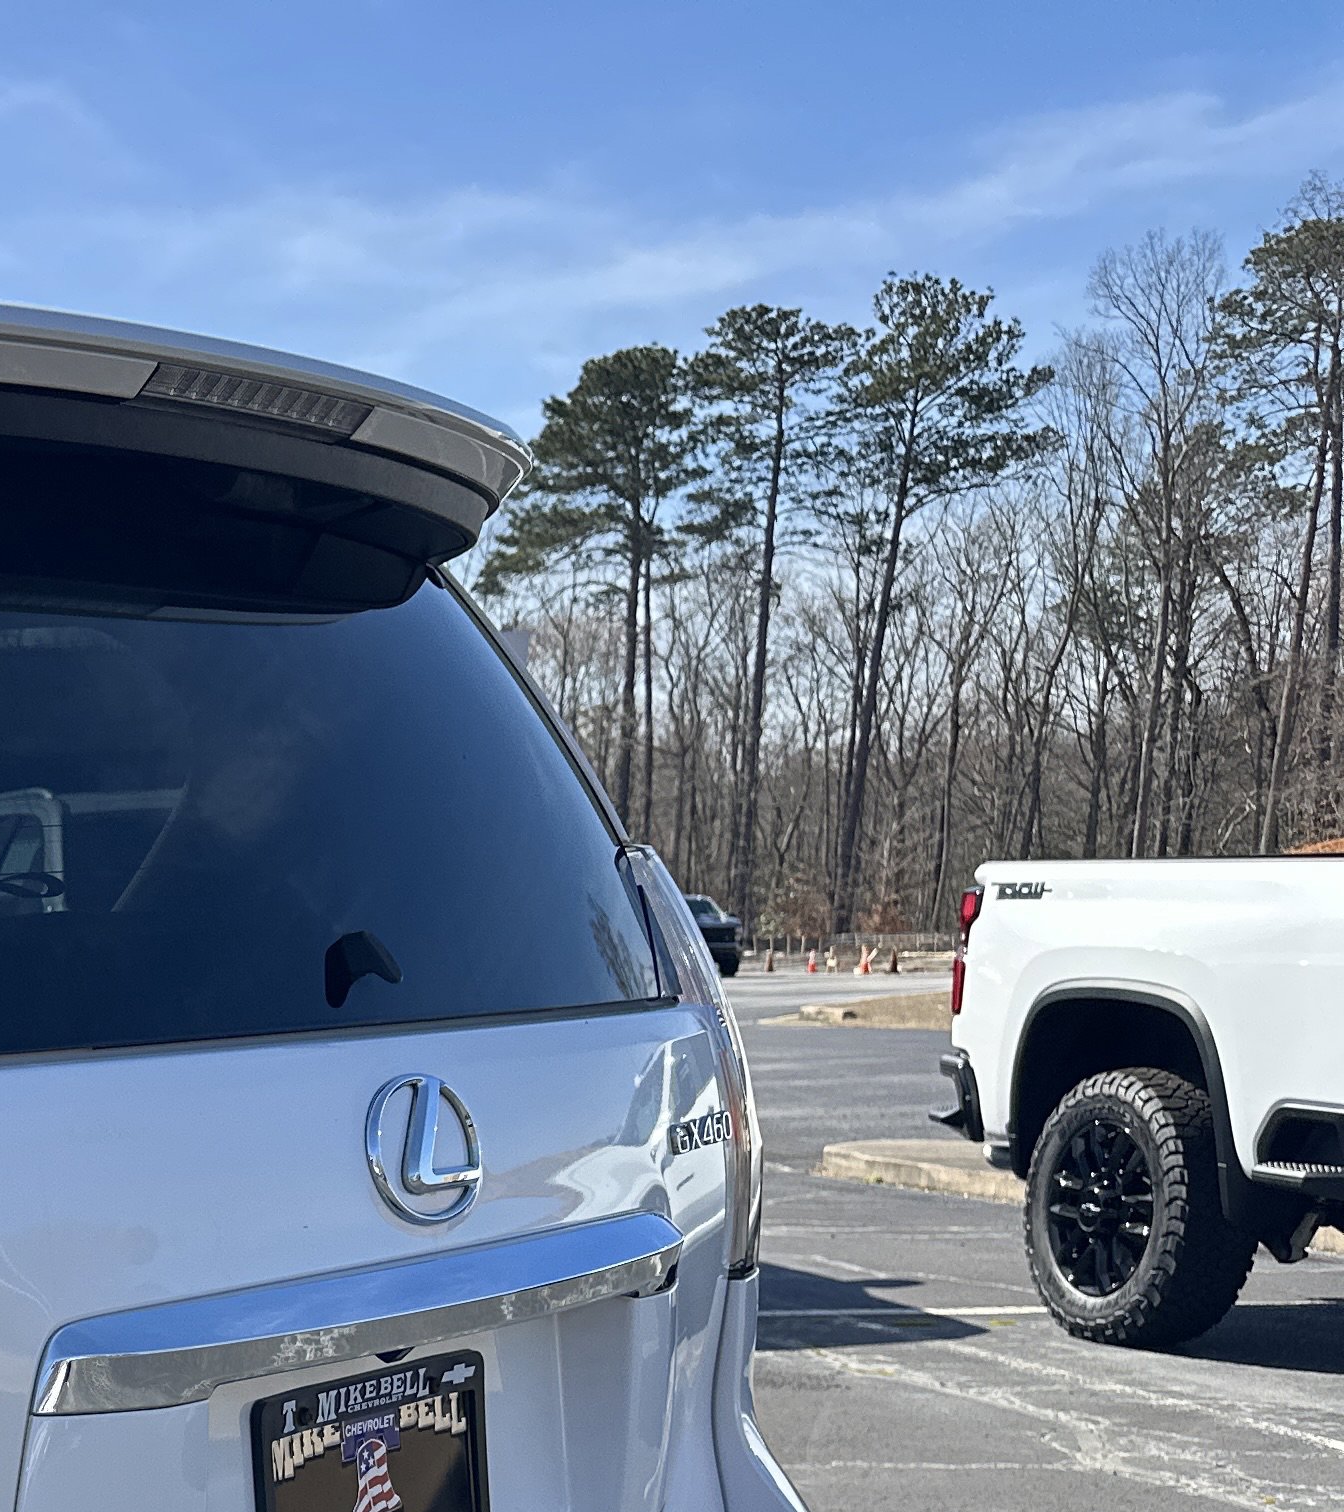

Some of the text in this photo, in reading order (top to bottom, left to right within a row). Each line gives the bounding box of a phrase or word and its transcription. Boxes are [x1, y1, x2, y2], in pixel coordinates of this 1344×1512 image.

[676, 1111, 733, 1153] GX460
[316, 1367, 430, 1424] MIKE BELL
[347, 1392, 403, 1414] CHEVROLET
[272, 1391, 467, 1482] MIKE BELL
[344, 1413, 396, 1438] CHEVROLET
